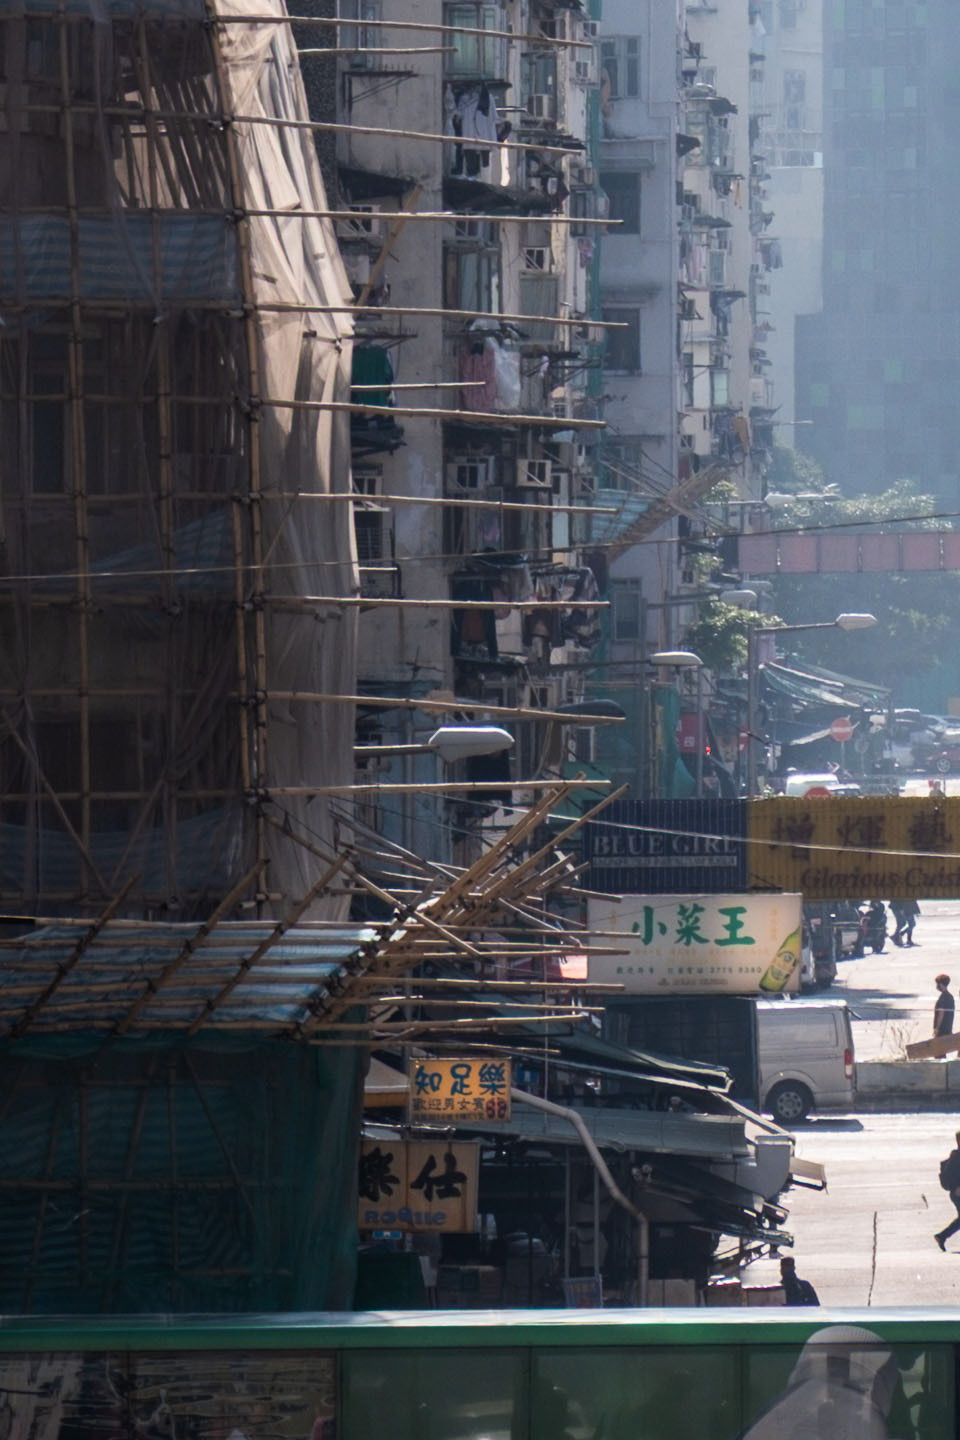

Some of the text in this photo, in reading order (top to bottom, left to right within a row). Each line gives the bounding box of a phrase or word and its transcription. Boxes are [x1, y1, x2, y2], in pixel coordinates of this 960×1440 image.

[593, 835, 737, 856] BLUE GIRL
[802, 865, 900, 890] Glorious
[631, 903, 756, 947] 小菜王
[415, 1062, 507, 1096] 知足樂
